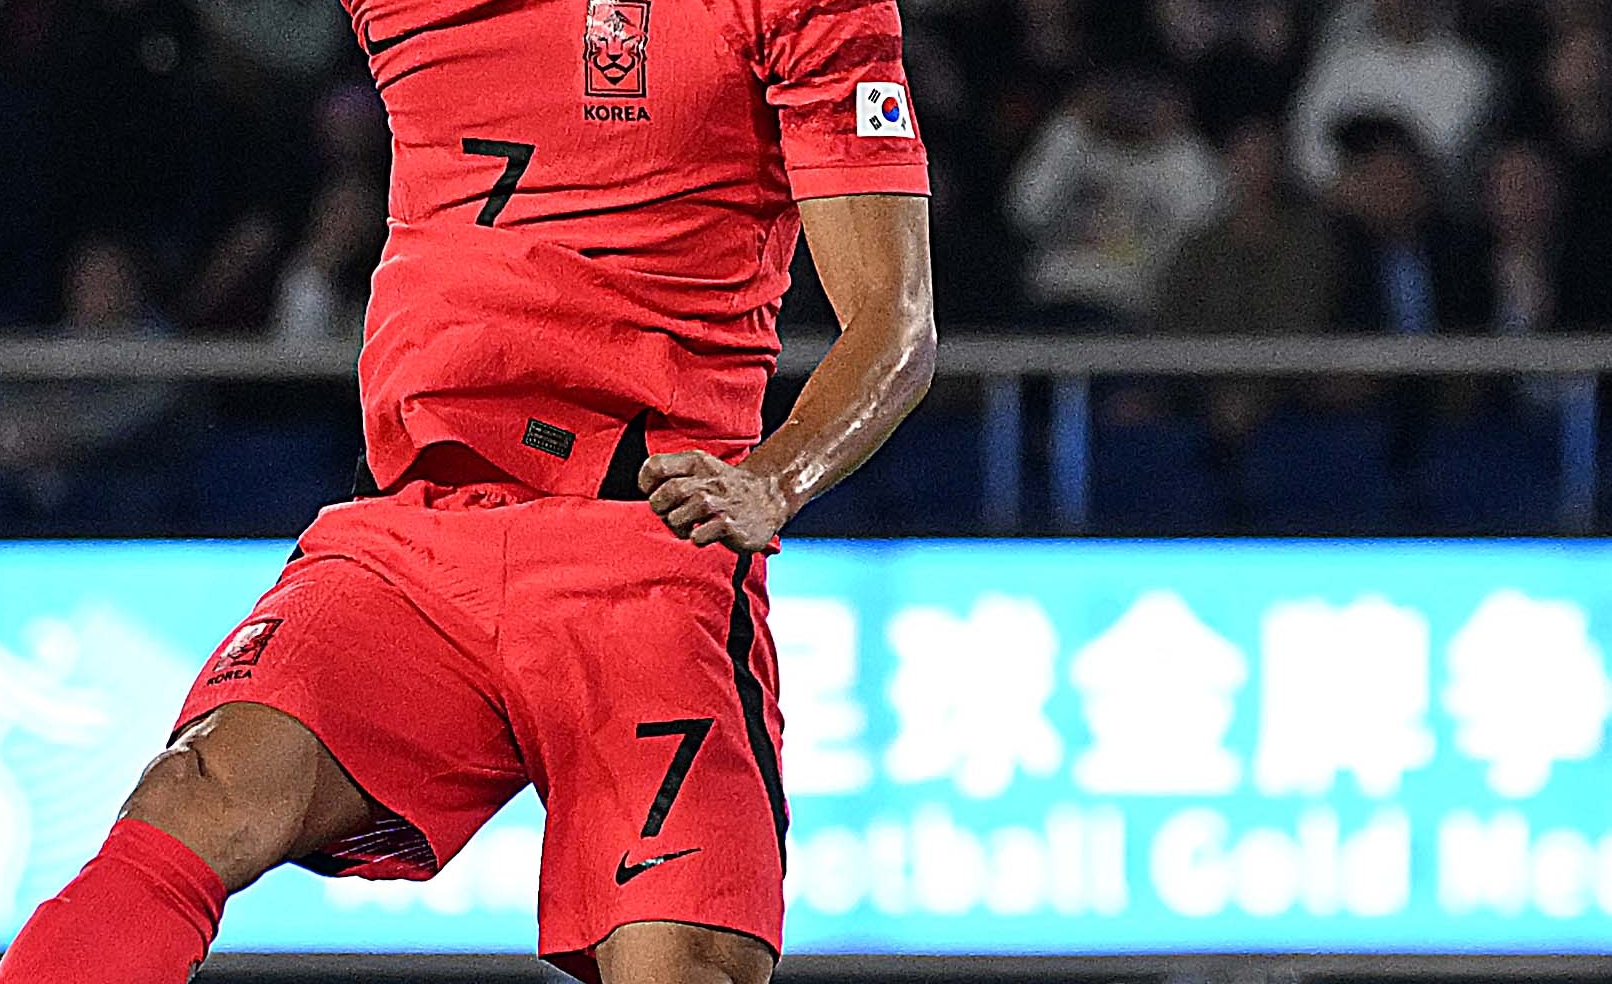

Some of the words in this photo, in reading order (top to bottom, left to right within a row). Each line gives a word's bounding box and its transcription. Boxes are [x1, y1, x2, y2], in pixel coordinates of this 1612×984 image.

[583, 103, 651, 122] KOREA
[461, 137, 536, 228] 7
[206, 669, 253, 686] KOREA
[634, 717, 716, 839] 7
[1150, 804, 1414, 921] Gold
